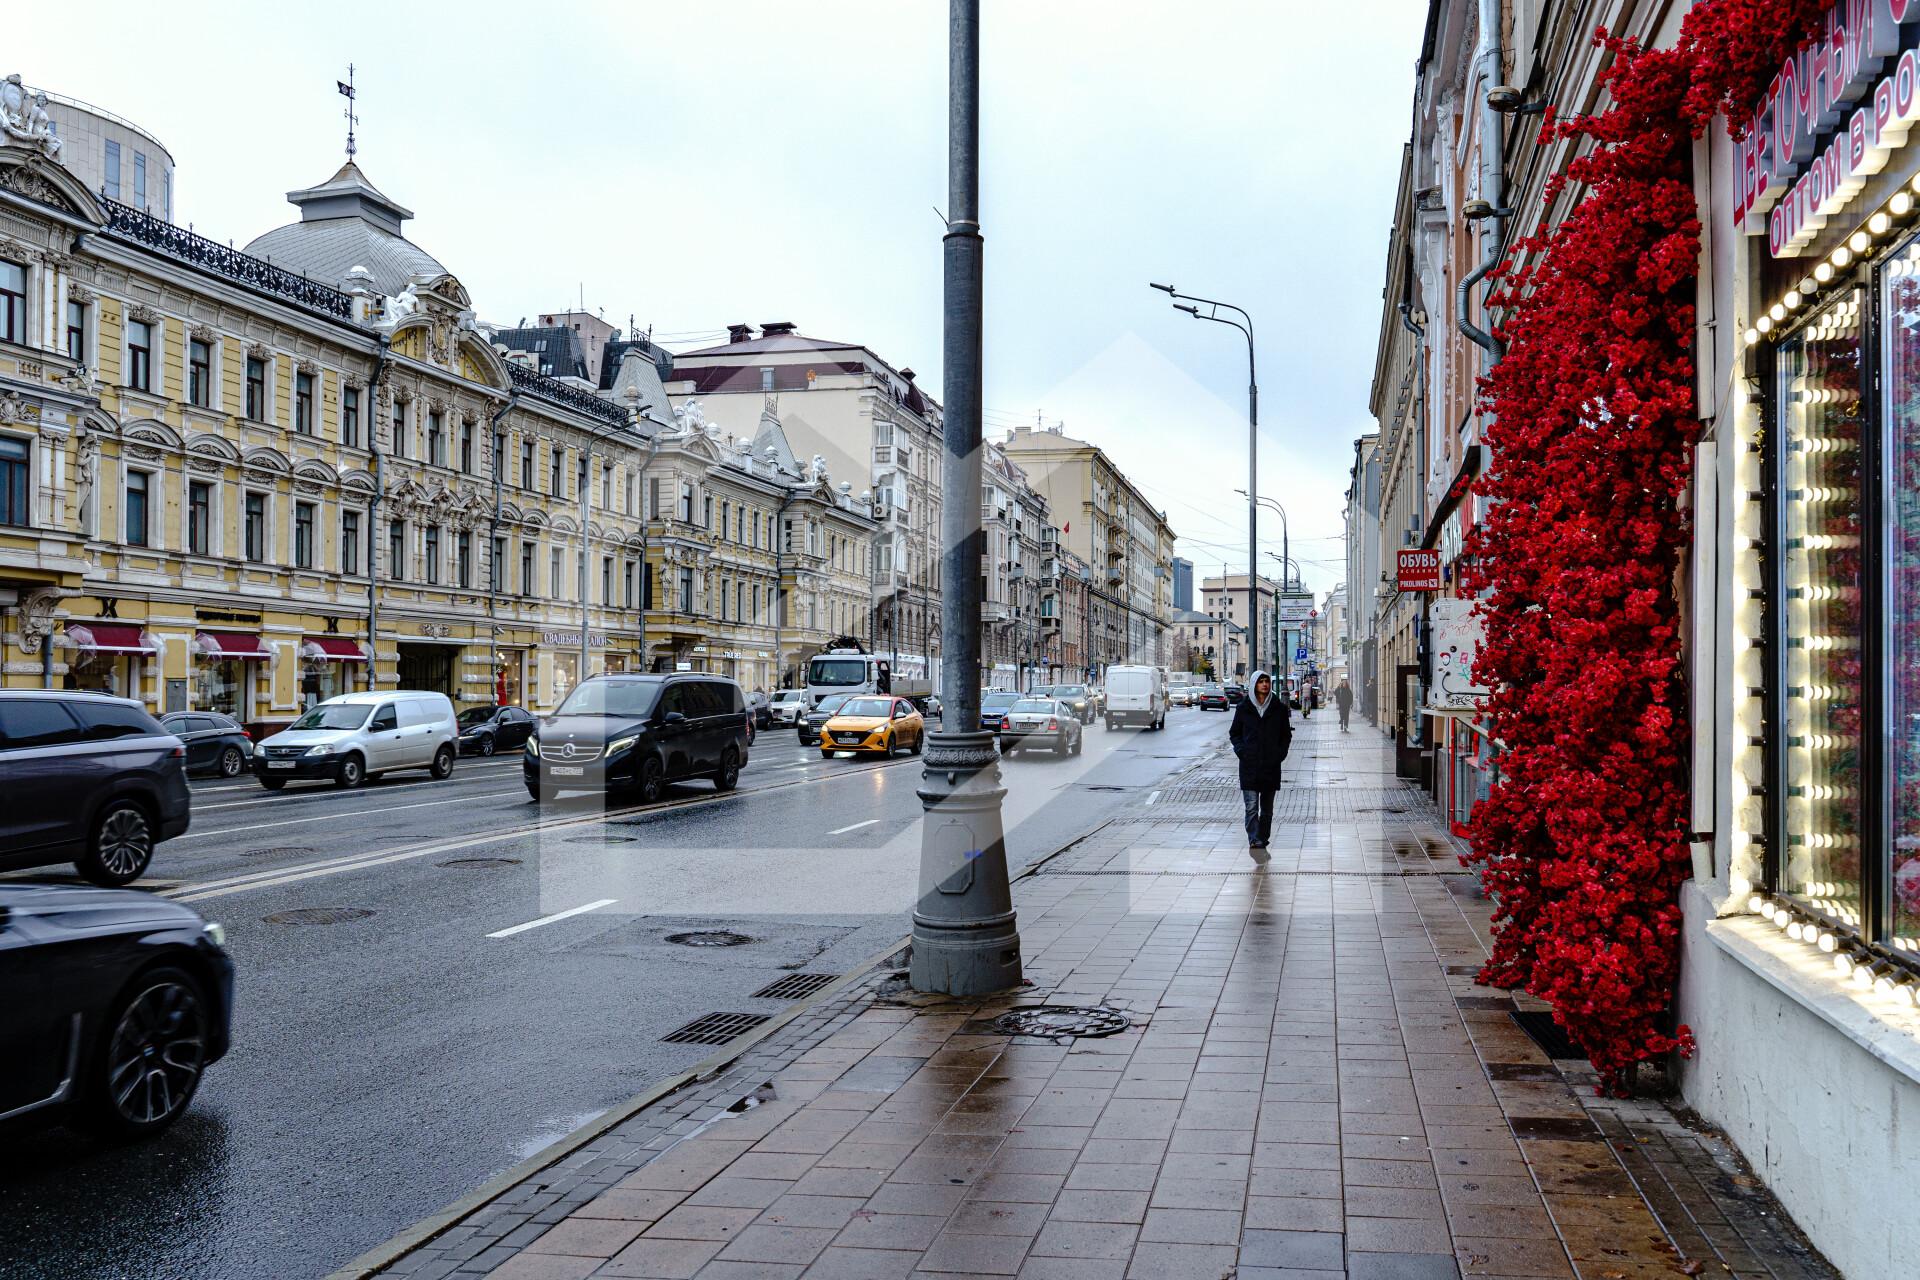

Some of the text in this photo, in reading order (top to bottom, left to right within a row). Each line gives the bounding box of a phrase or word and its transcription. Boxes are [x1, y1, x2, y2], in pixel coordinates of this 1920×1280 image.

[1770, 132, 1843, 259] ОПТОМ
[1849, 107, 1865, 174] В
[1873, 40, 1920, 146] РО
[1400, 553, 1437, 568] ОБУВЬ
[588, 635, 607, 647] АЛОН
[1299, 649, 1307, 658] P
